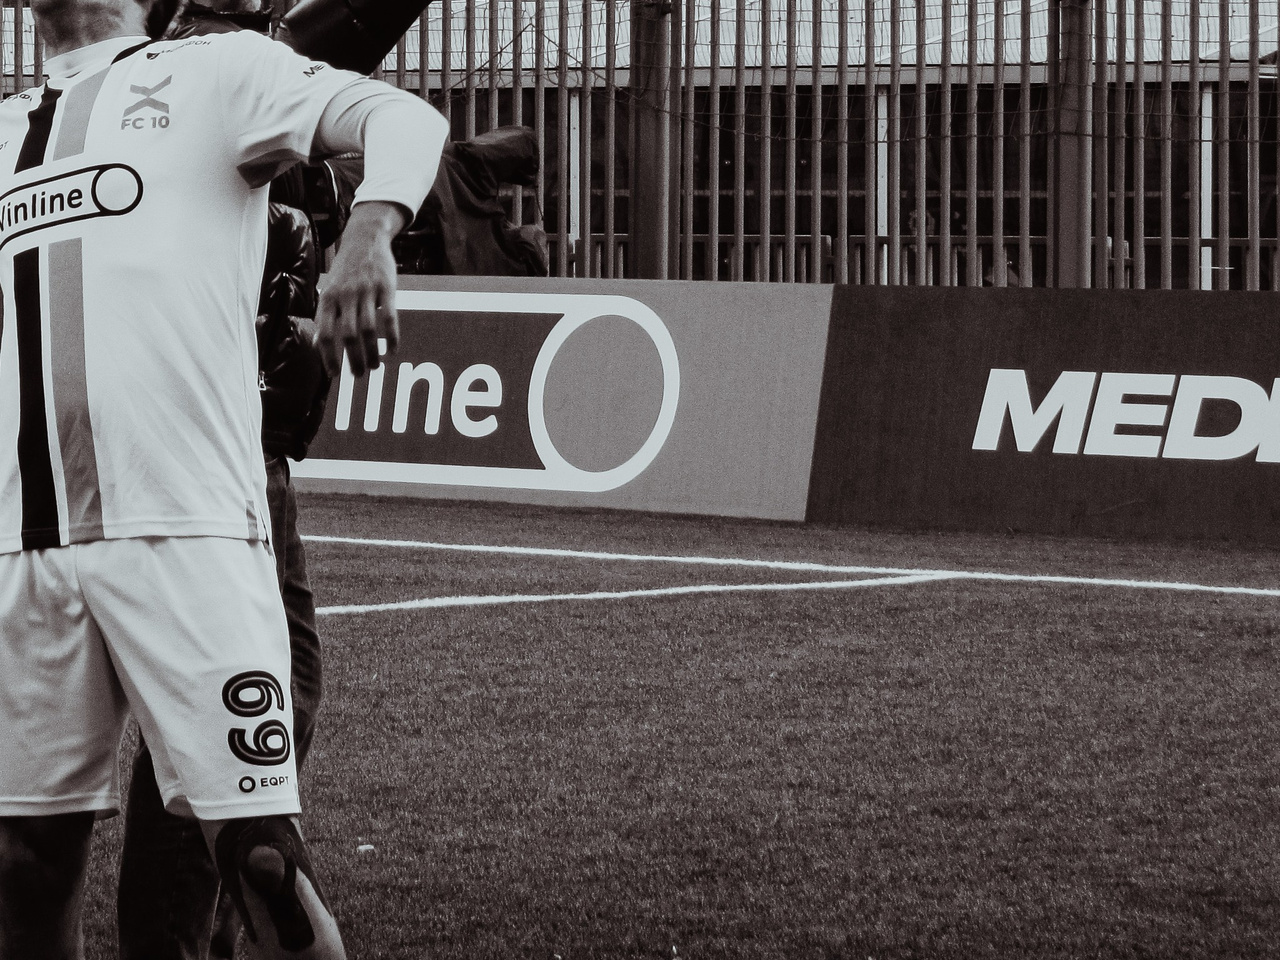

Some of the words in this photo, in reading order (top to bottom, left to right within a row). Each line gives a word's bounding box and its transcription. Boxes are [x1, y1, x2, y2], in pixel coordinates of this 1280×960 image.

[121, 117, 145, 131] FC
[151, 115, 170, 129] 10
[334, 337, 503, 438] line
[222, 670, 291, 767] 69
[260, 776, 289, 788] EQPT
